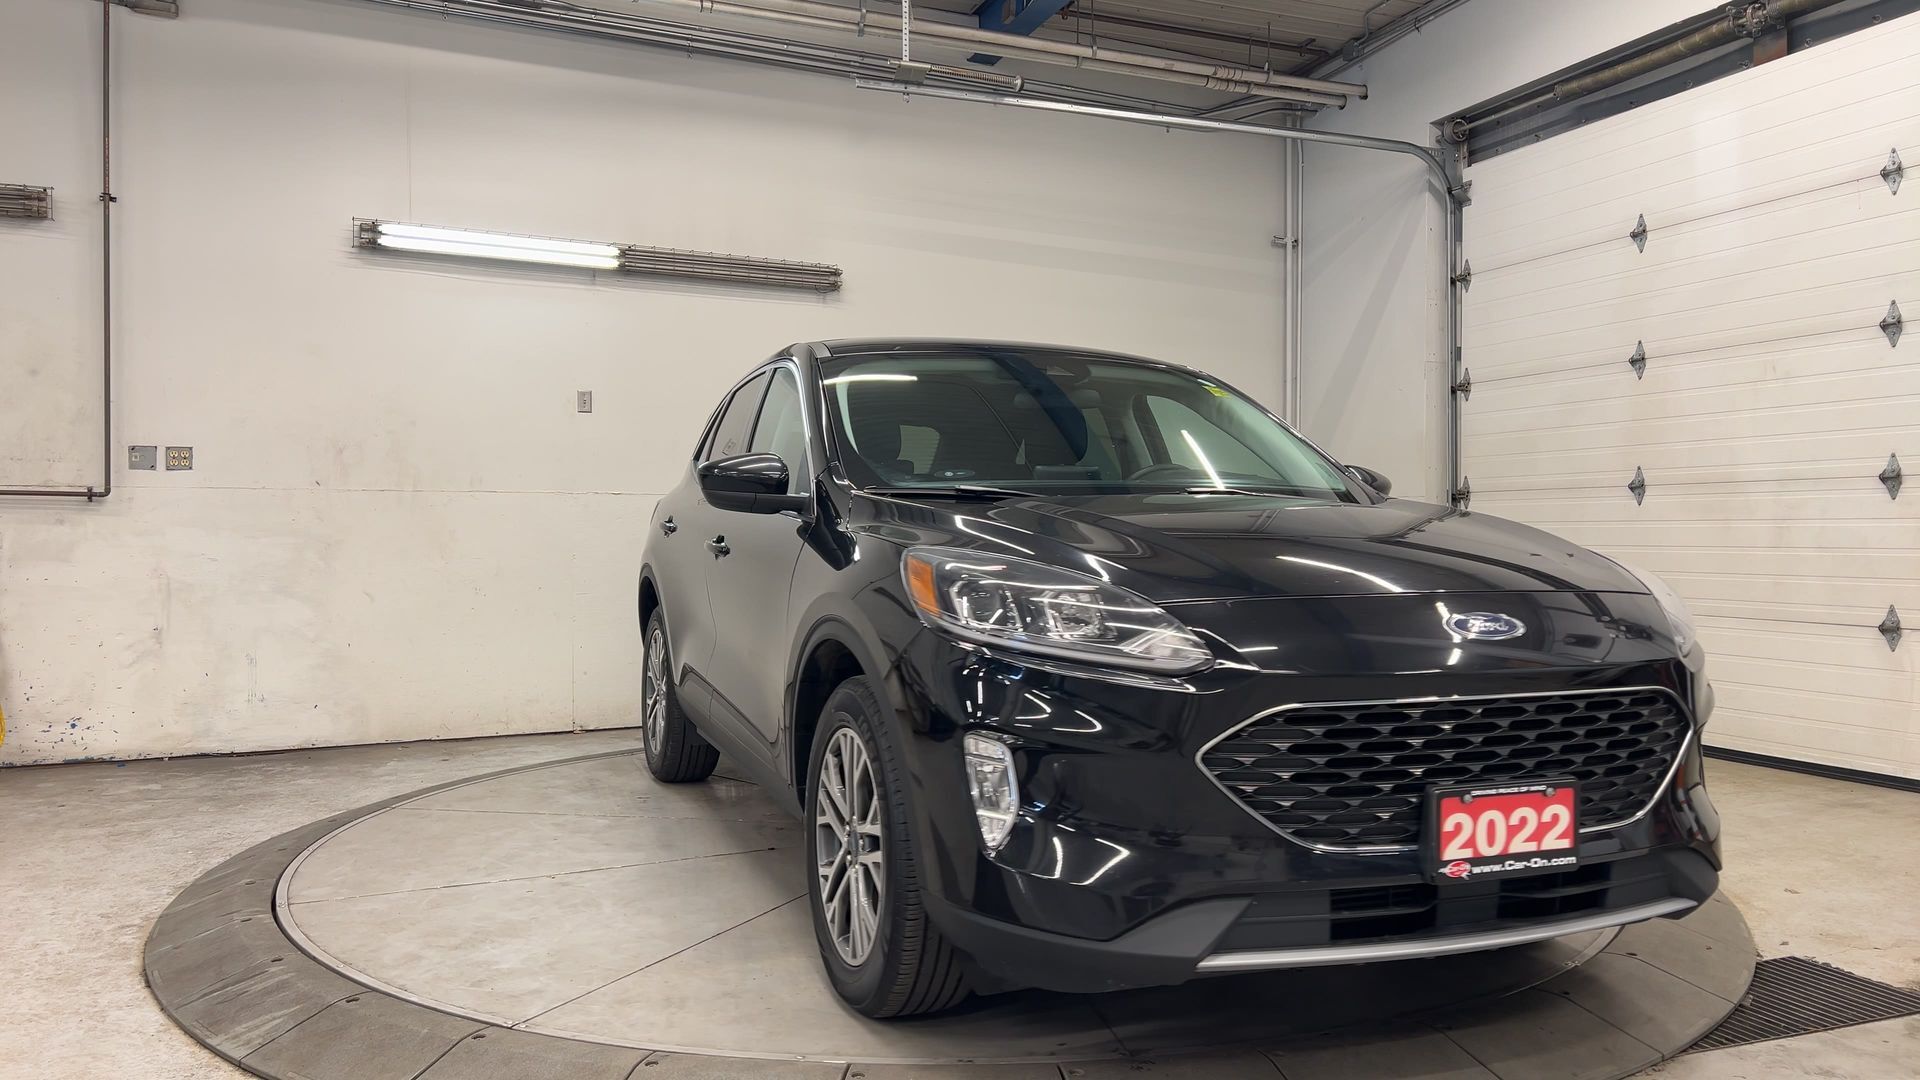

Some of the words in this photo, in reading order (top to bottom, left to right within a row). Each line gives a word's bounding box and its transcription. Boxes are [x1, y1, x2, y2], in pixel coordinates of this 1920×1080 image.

[1466, 616, 1509, 632] Ford
[1441, 804, 1571, 861] 2022
[1471, 856, 1577, 874] www.Car-On.com
